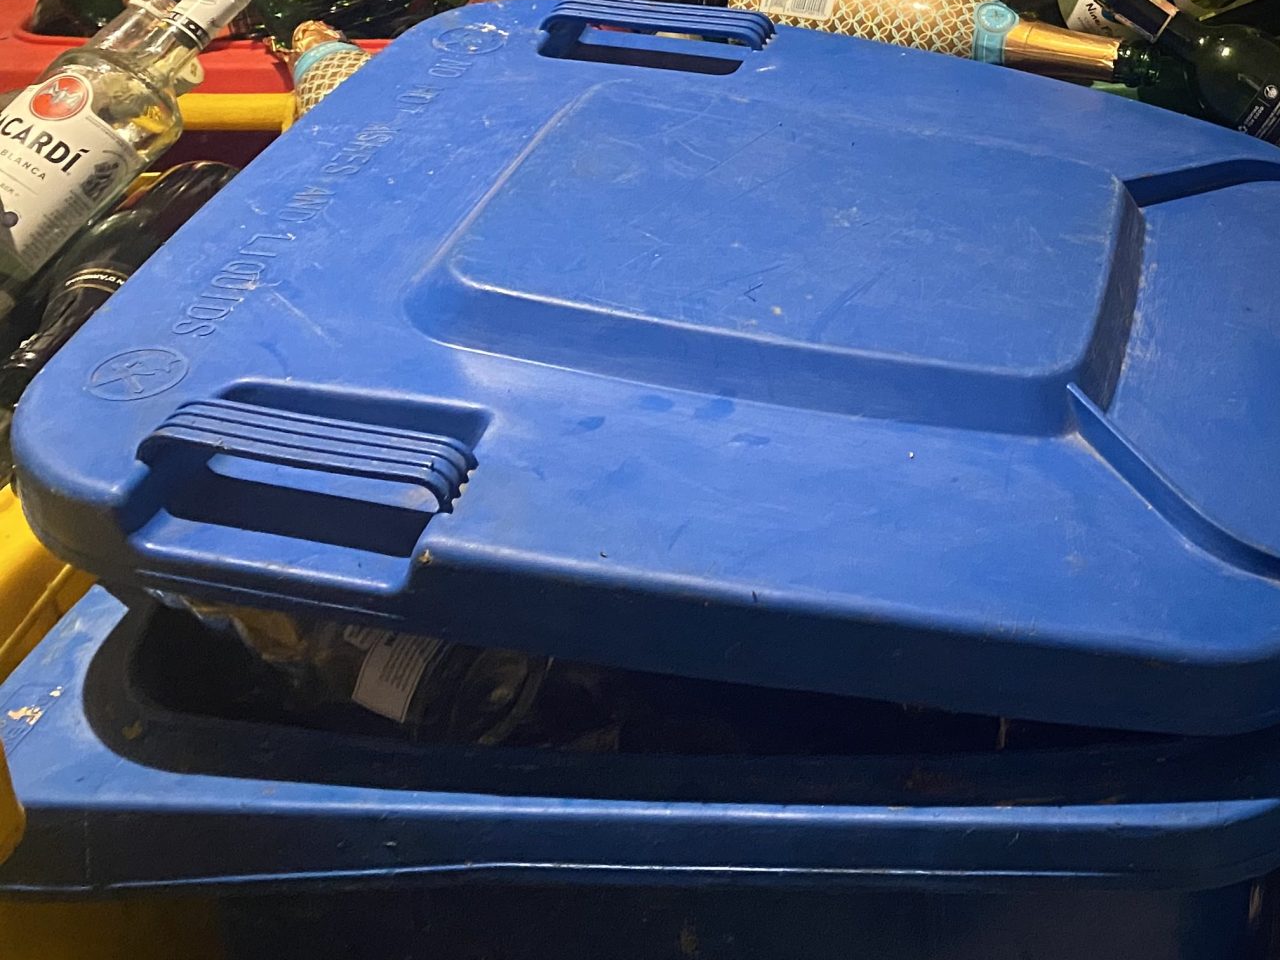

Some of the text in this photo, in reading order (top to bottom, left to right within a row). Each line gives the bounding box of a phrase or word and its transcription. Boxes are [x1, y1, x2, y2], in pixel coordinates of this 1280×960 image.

[1085, 2, 1101, 26] Nine
[0, 148, 47, 180] BLANCA
[171, 232, 298, 339] LIQUIDS
